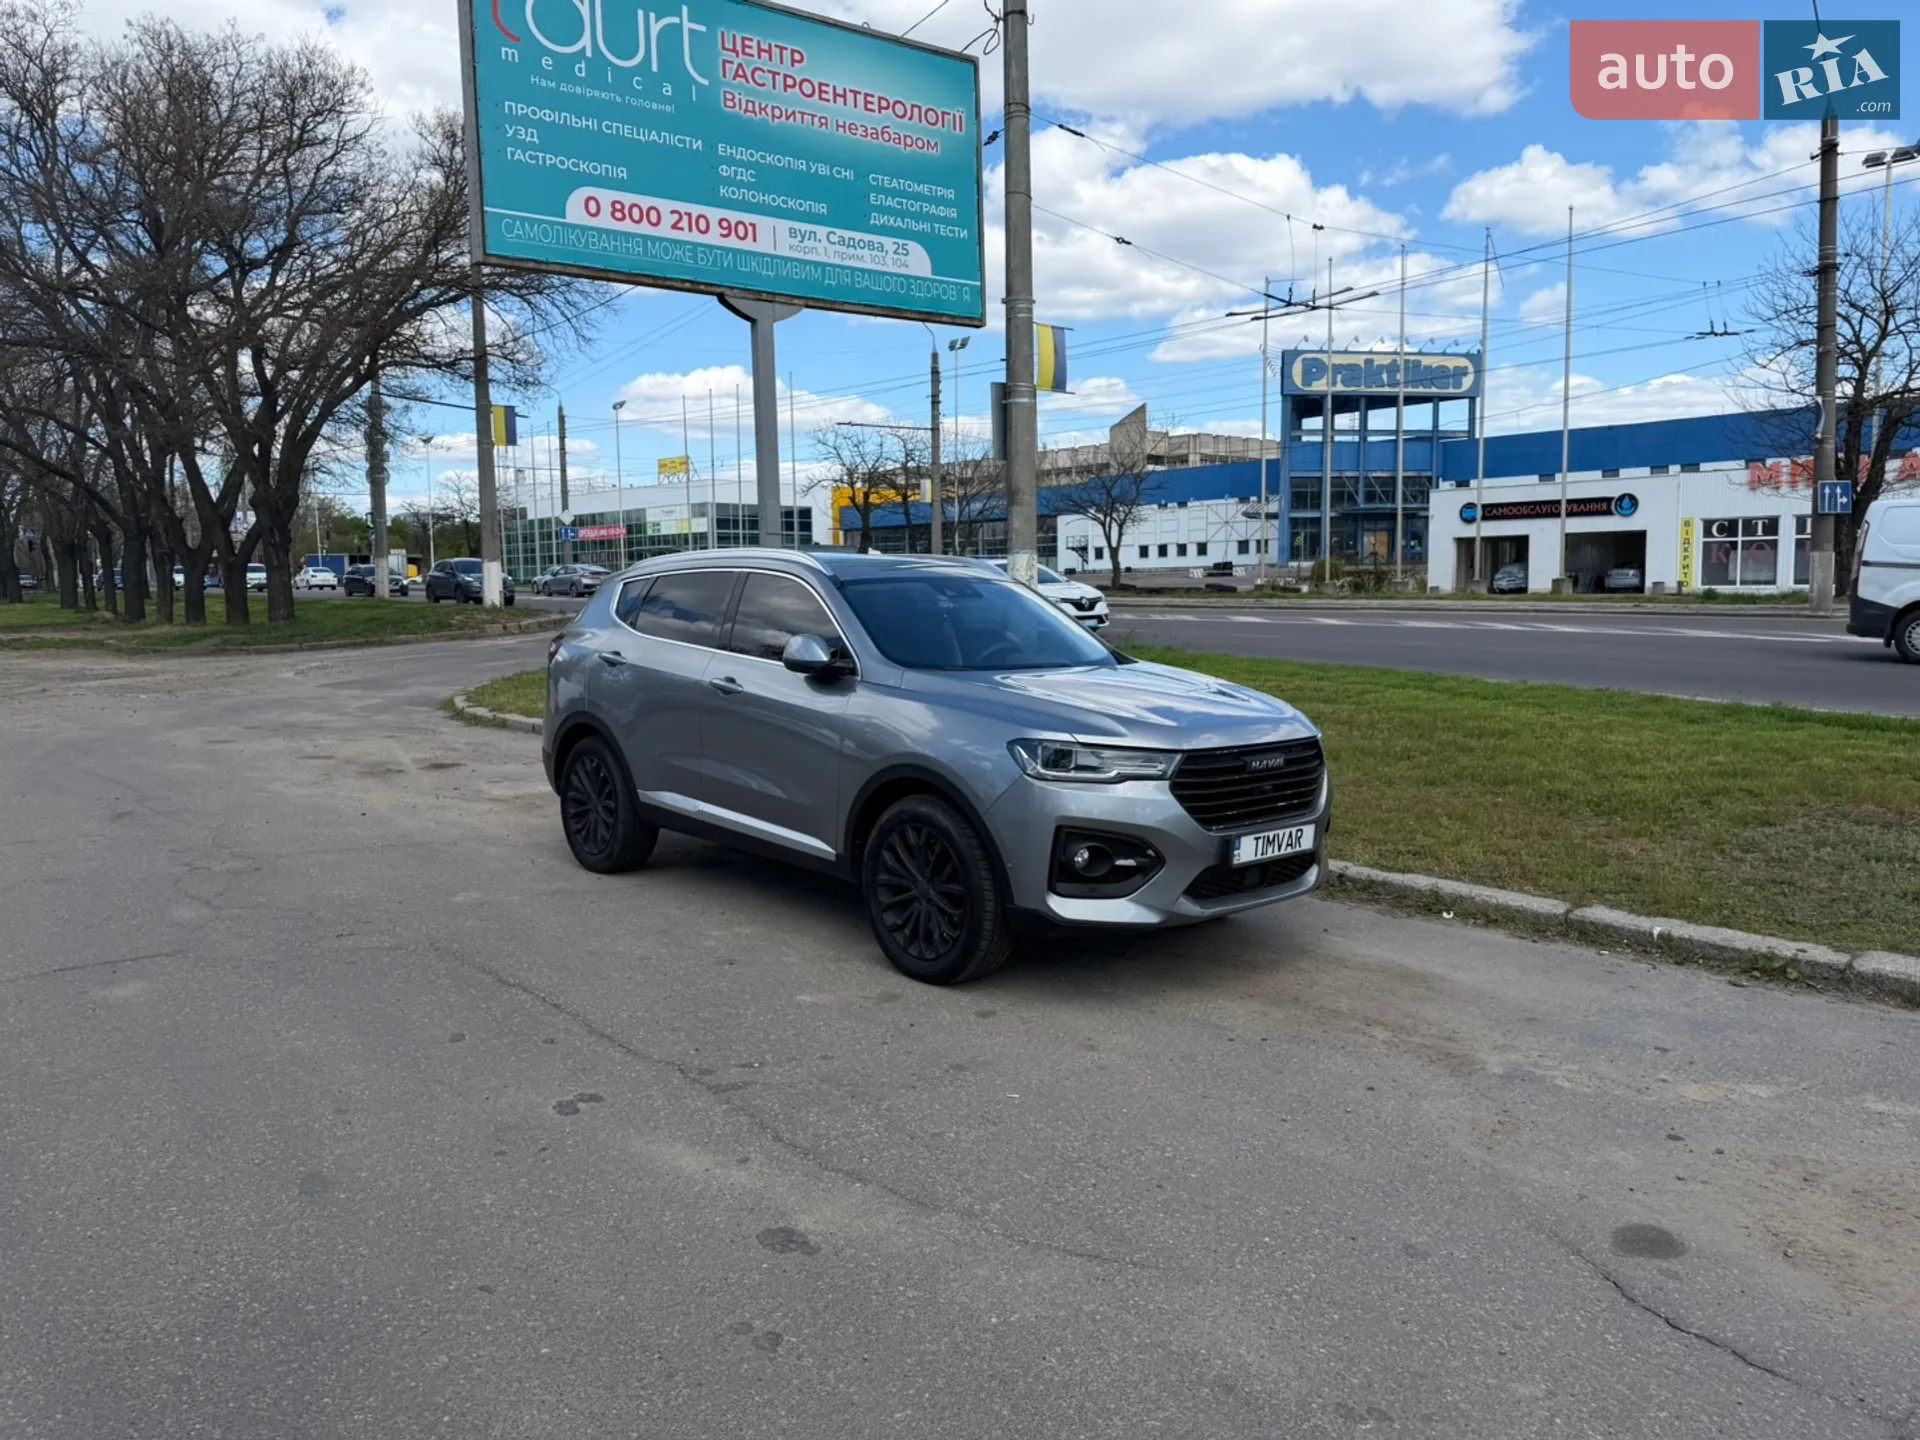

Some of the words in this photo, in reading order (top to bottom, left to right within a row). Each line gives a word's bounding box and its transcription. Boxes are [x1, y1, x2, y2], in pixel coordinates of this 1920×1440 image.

[720, 30, 806, 68] ЦЕНТР
[530, 74, 556, 89] Нам
[560, 82, 622, 103] довіряють
[625, 96, 675, 113] головне!
[721, 58, 964, 133] ГАСТРОЕНТЕРОЛОГІЇ
[504, 101, 598, 131] ПРОФІЛЬНІ
[602, 121, 703, 151] СПЕЦІАЛІСТИ
[504, 124, 539, 144] УЗД
[722, 90, 829, 130] Відкриття
[835, 118, 939, 153] незабаром
[506, 147, 627, 180] ГАСТРОСКОПІЯ
[718, 143, 807, 172] ЕНДОСКОПІЯ
[810, 160, 830, 176] УВІ
[832, 166, 855, 181] СНІ
[718, 164, 757, 183] ФГДС
[719, 185, 828, 215] КОЛОНОСКОПІЯ
[869, 173, 955, 200] СТЕАТОМЕТРІЯ
[583, 195, 601, 218] 0
[610, 199, 662, 228] 800
[670, 209, 710, 235] 210
[718, 217, 758, 243] 901
[869, 193, 957, 219] ЕЛАСТОГРАФІЯ
[870, 212, 931, 234] ДИХАЛЬНІ
[933, 223, 968, 240] ТЕСТИ
[501, 218, 643, 256] САМОЛІКУВАННЯ
[647, 239, 694, 263] МОЖЕ
[697, 248, 733, 269] БУТИ
[737, 254, 822, 282] ШКІДЛИВИМ
[824, 266, 851, 287] ДЛЯ
[854, 270, 906, 293] ВАШОГО
[788, 227, 821, 245] вул.
[826, 230, 888, 255] Садова,
[892, 241, 910, 257] 25
[788, 243, 821, 258] корп.
[833, 249, 867, 265] прим.
[890, 256, 908, 269] 104
[1301, 356, 1469, 390] Praktiker
[1485, 502, 1608, 516] САМООБСЛУГОУВАННЯ
[1253, 828, 1304, 858] TIMVAR
